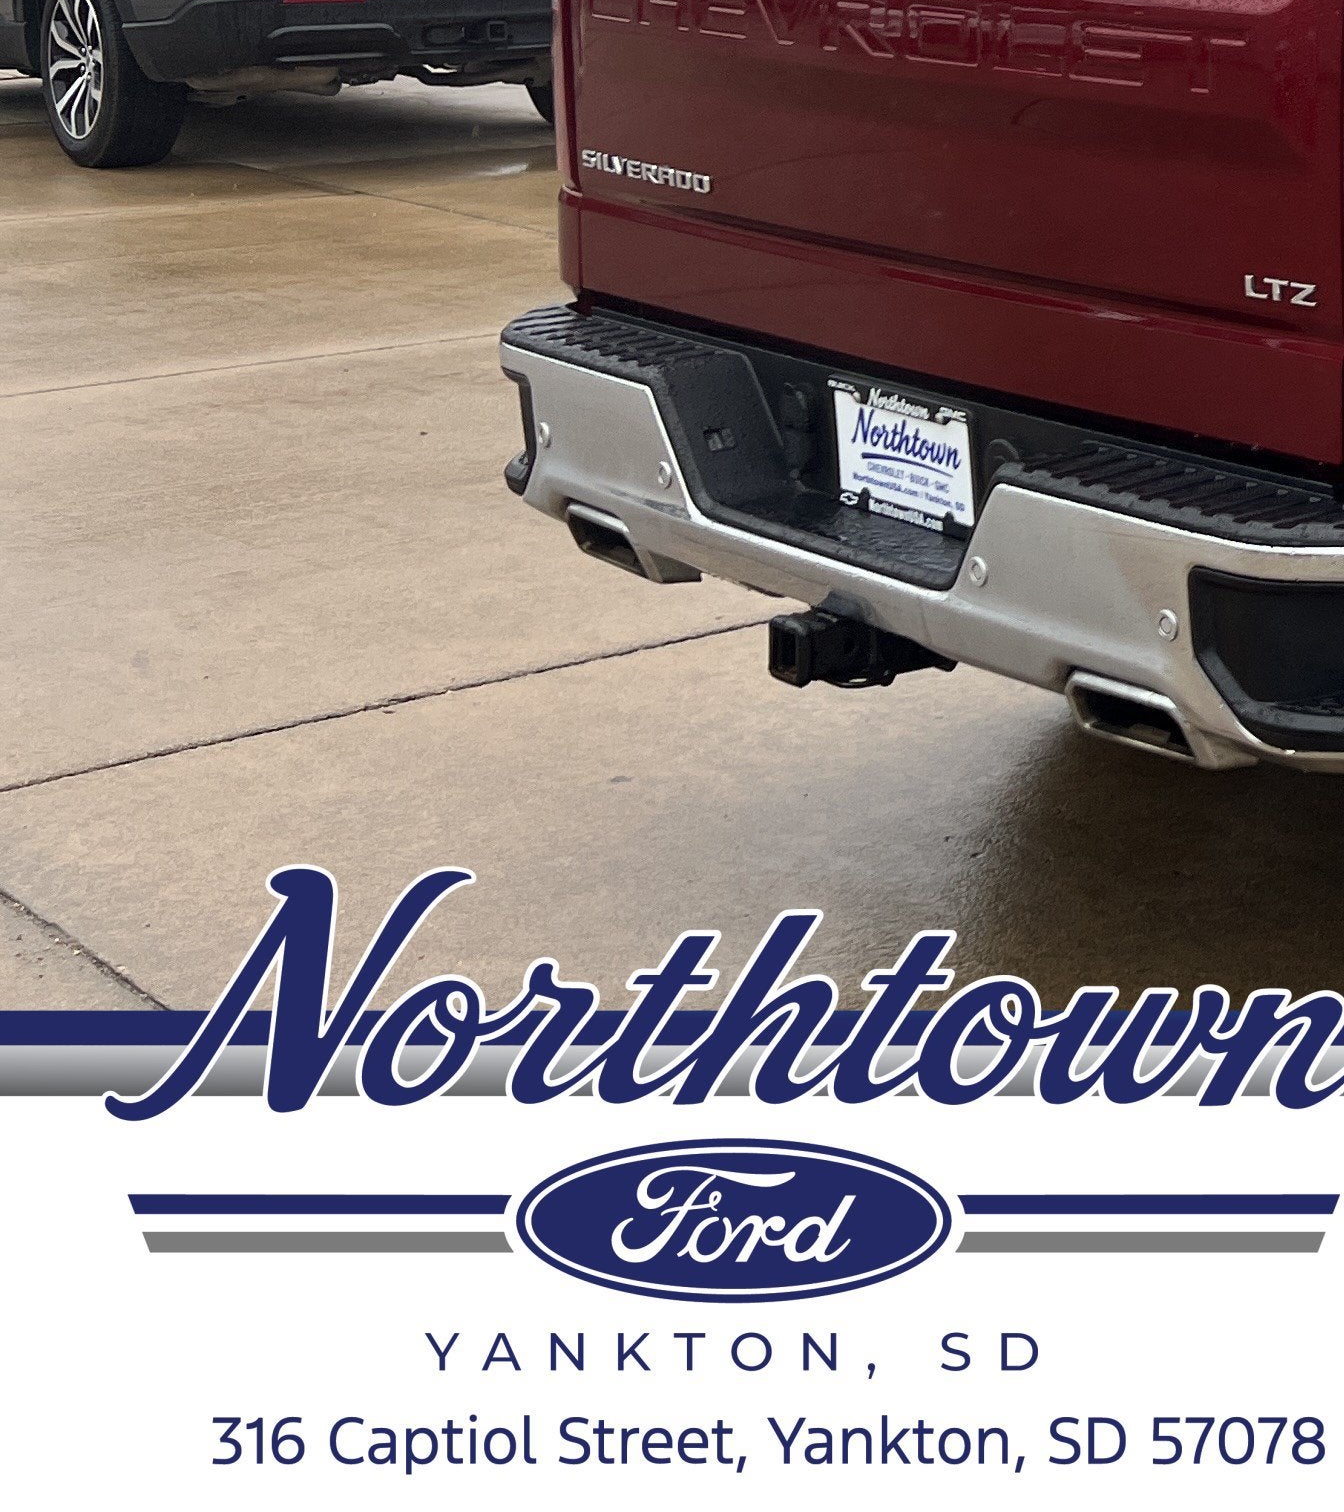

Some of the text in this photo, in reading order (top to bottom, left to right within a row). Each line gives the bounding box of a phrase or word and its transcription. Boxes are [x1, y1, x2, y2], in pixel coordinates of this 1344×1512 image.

[581, 148, 711, 194] SILVERADO
[1244, 274, 1318, 307] LTZ
[867, 387, 930, 420] Northtown
[851, 406, 962, 470] Northtown
